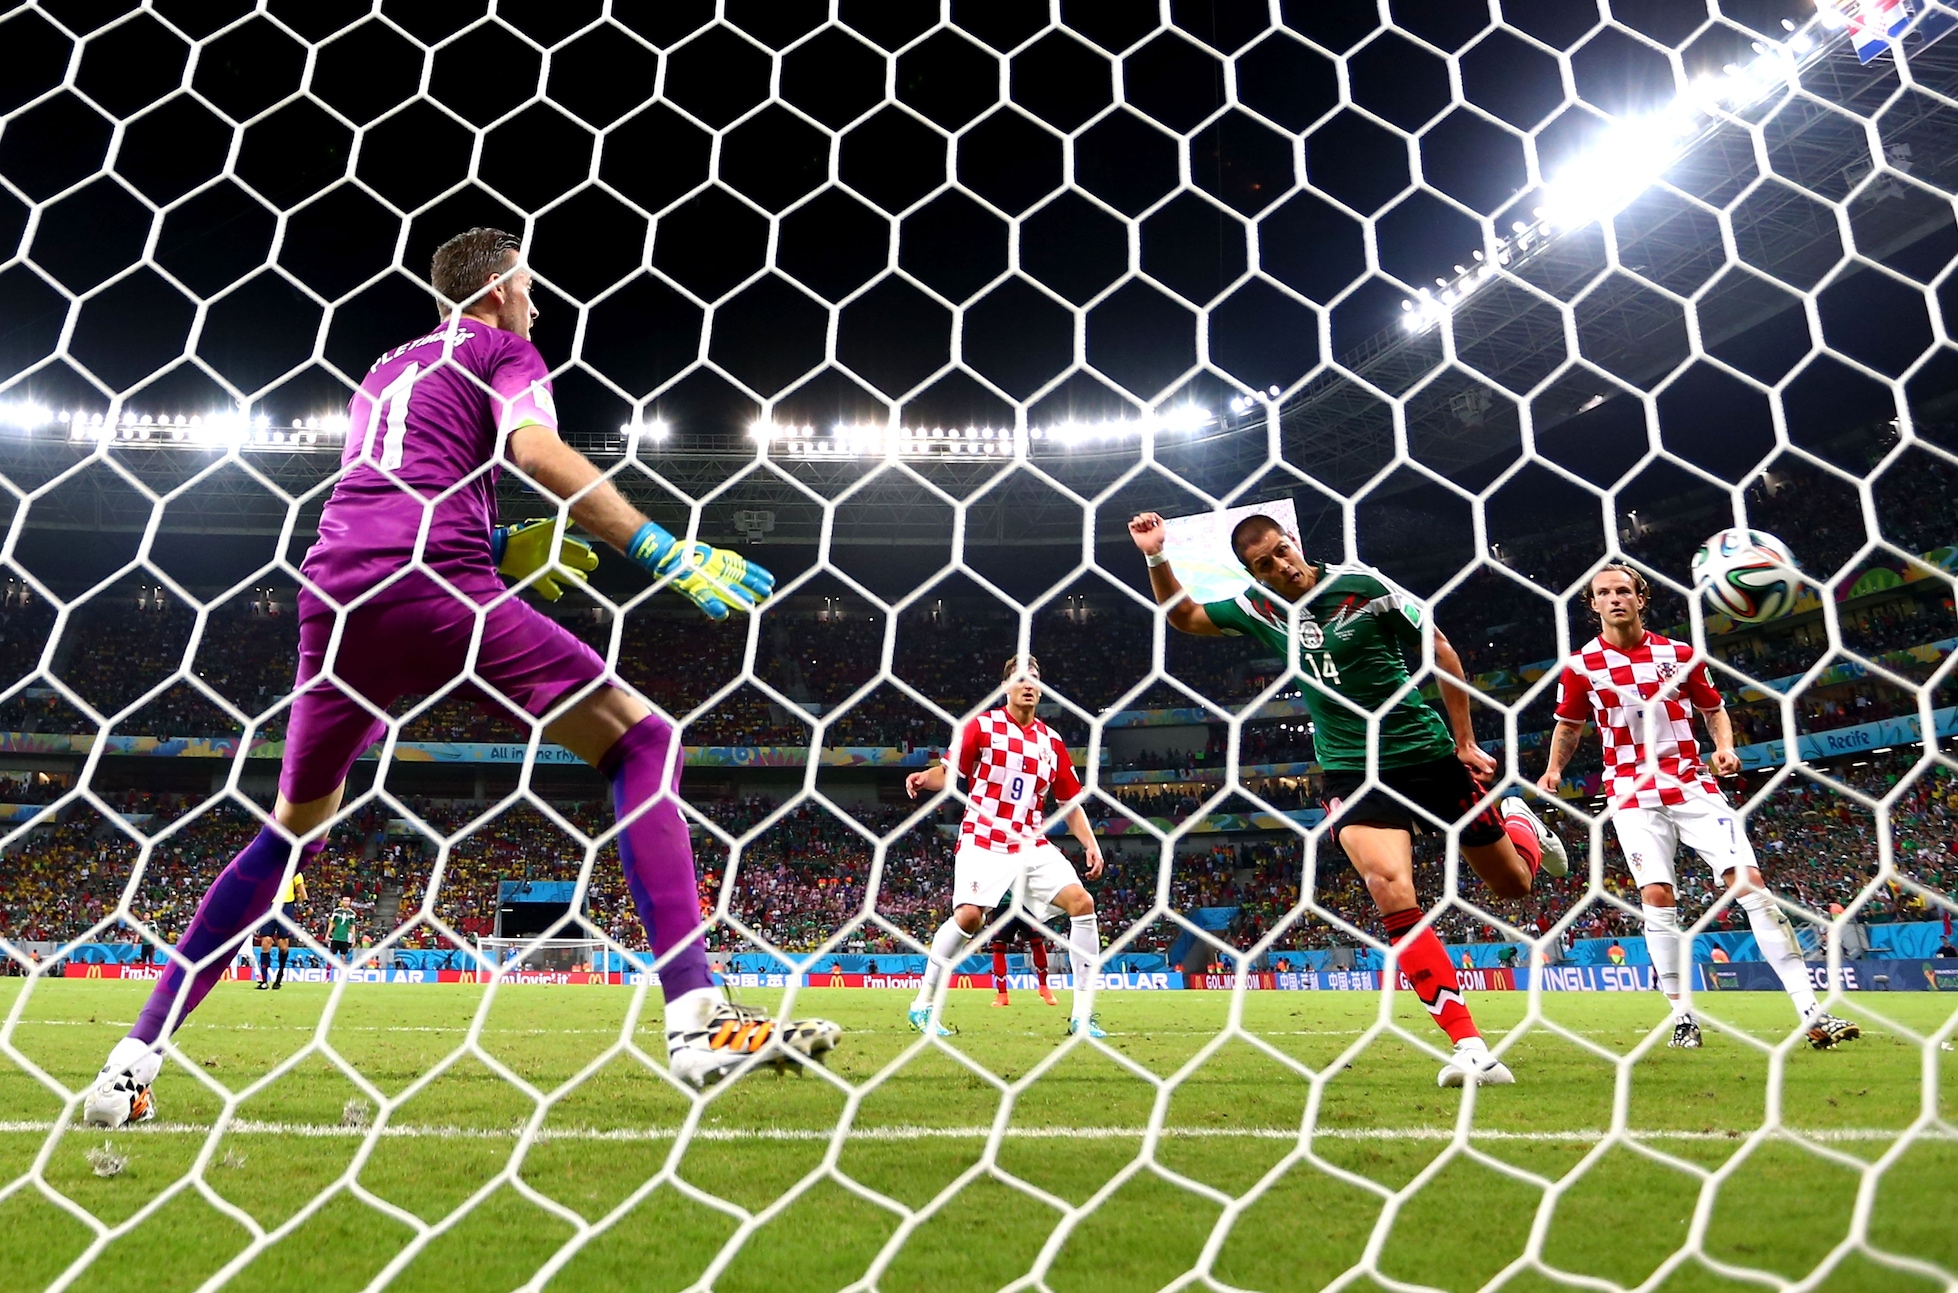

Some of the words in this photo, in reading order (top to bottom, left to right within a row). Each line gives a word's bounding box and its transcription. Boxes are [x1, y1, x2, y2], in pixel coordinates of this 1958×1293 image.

[380, 360, 419, 471] 1
[1305, 652, 1341, 685] 14
[1827, 730, 1870, 749] Recife
[491, 747, 507, 759] All
[512, 747, 523, 759] in
[528, 749, 552, 759] ne
[556, 748, 579, 762] rhy
[1010, 777, 1024, 801] 9
[1717, 817, 1736, 845] 7
[349, 969, 424, 983] SOLAR
[1007, 973, 1074, 989] YINGL
[1540, 966, 1596, 991] INGLI
[1602, 966, 1663, 991] SOLA
